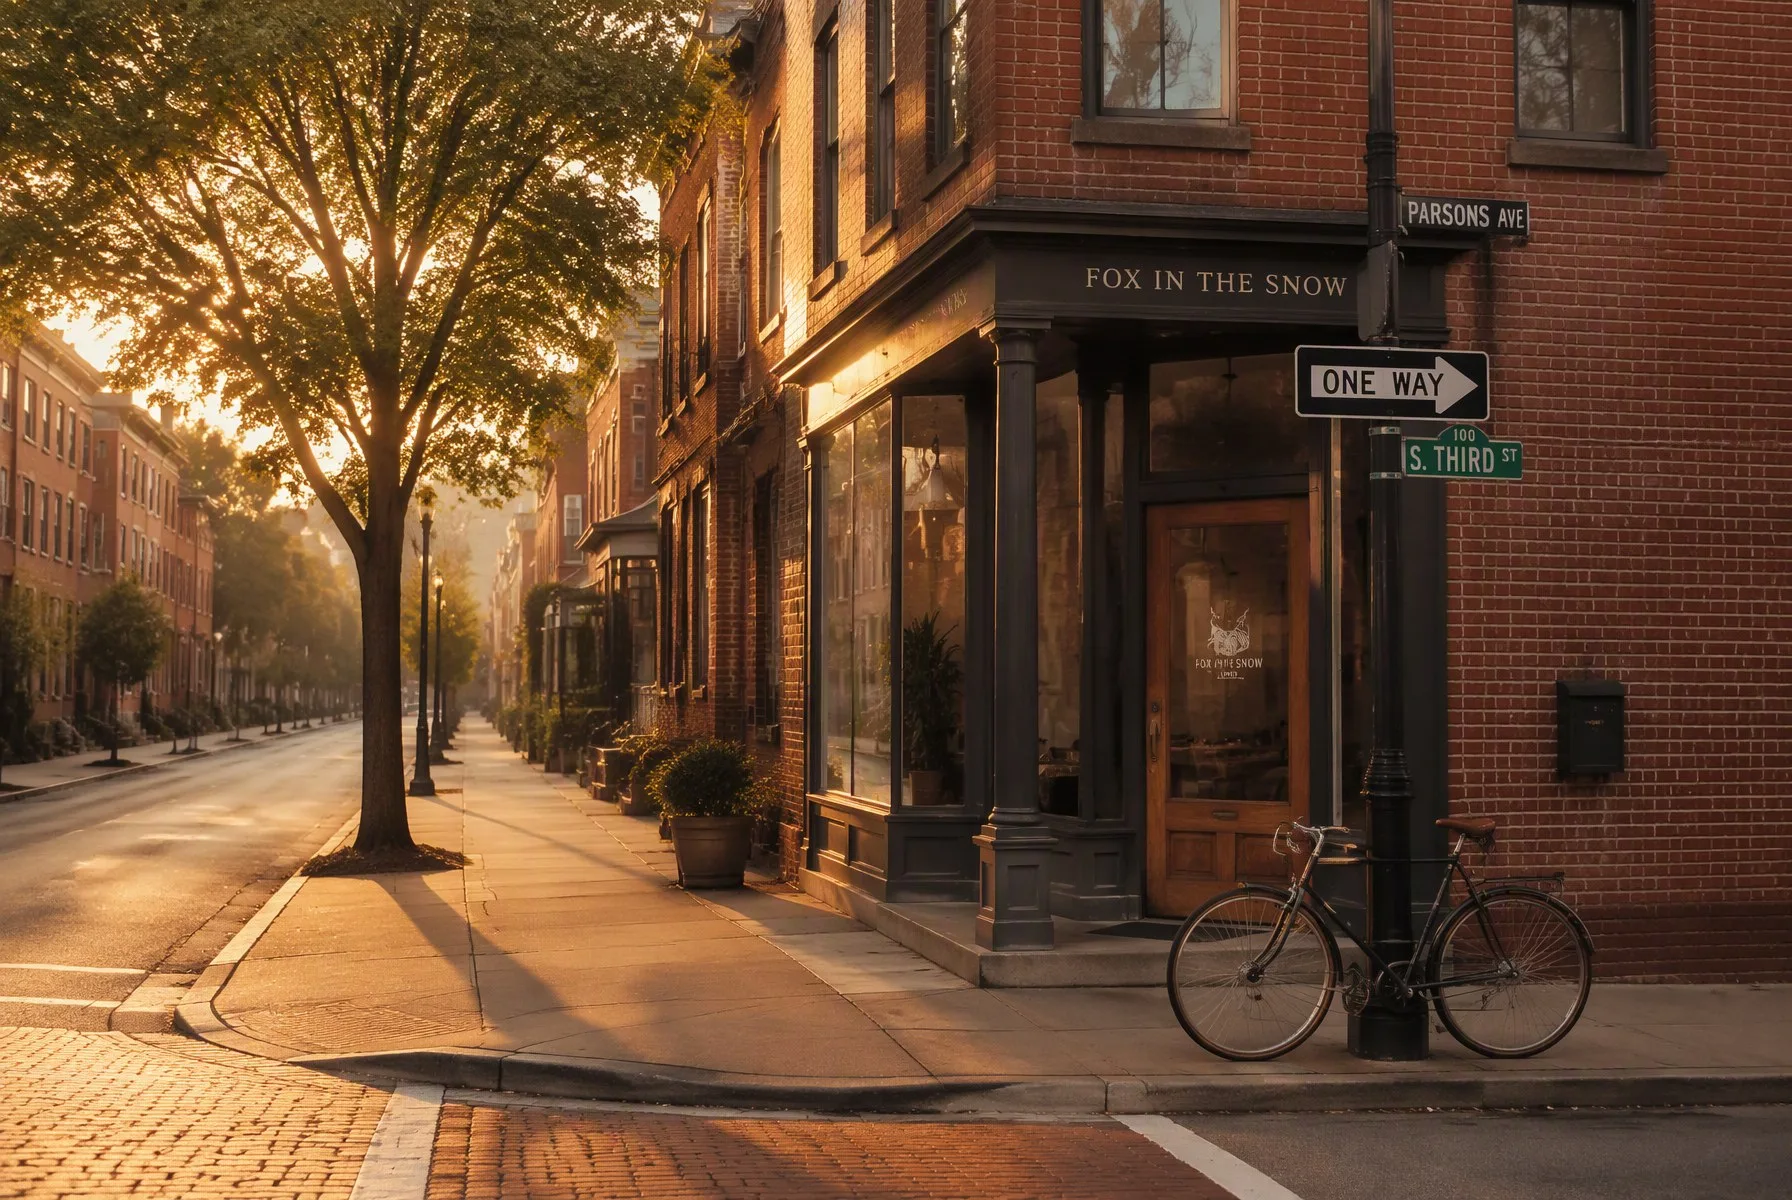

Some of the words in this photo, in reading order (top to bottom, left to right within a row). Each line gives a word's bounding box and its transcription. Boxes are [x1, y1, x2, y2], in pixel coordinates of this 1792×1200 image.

[1408, 201, 1490, 228] PARSONS
[1497, 207, 1525, 229] AVE
[1086, 267, 1142, 290] FOX
[1154, 270, 1184, 291] IN
[1197, 271, 1253, 293] THE
[1265, 274, 1348, 297] SNOW
[1323, 369, 1376, 395] ONE
[1392, 371, 1444, 397] WAY
[1453, 428, 1475, 442] 100
[1410, 445, 1427, 471] S.
[1433, 445, 1495, 473] THIRD
[1501, 447, 1518, 461] ST
[1195, 658, 1211, 669] FOX
[1235, 657, 1263, 669] SNOW
